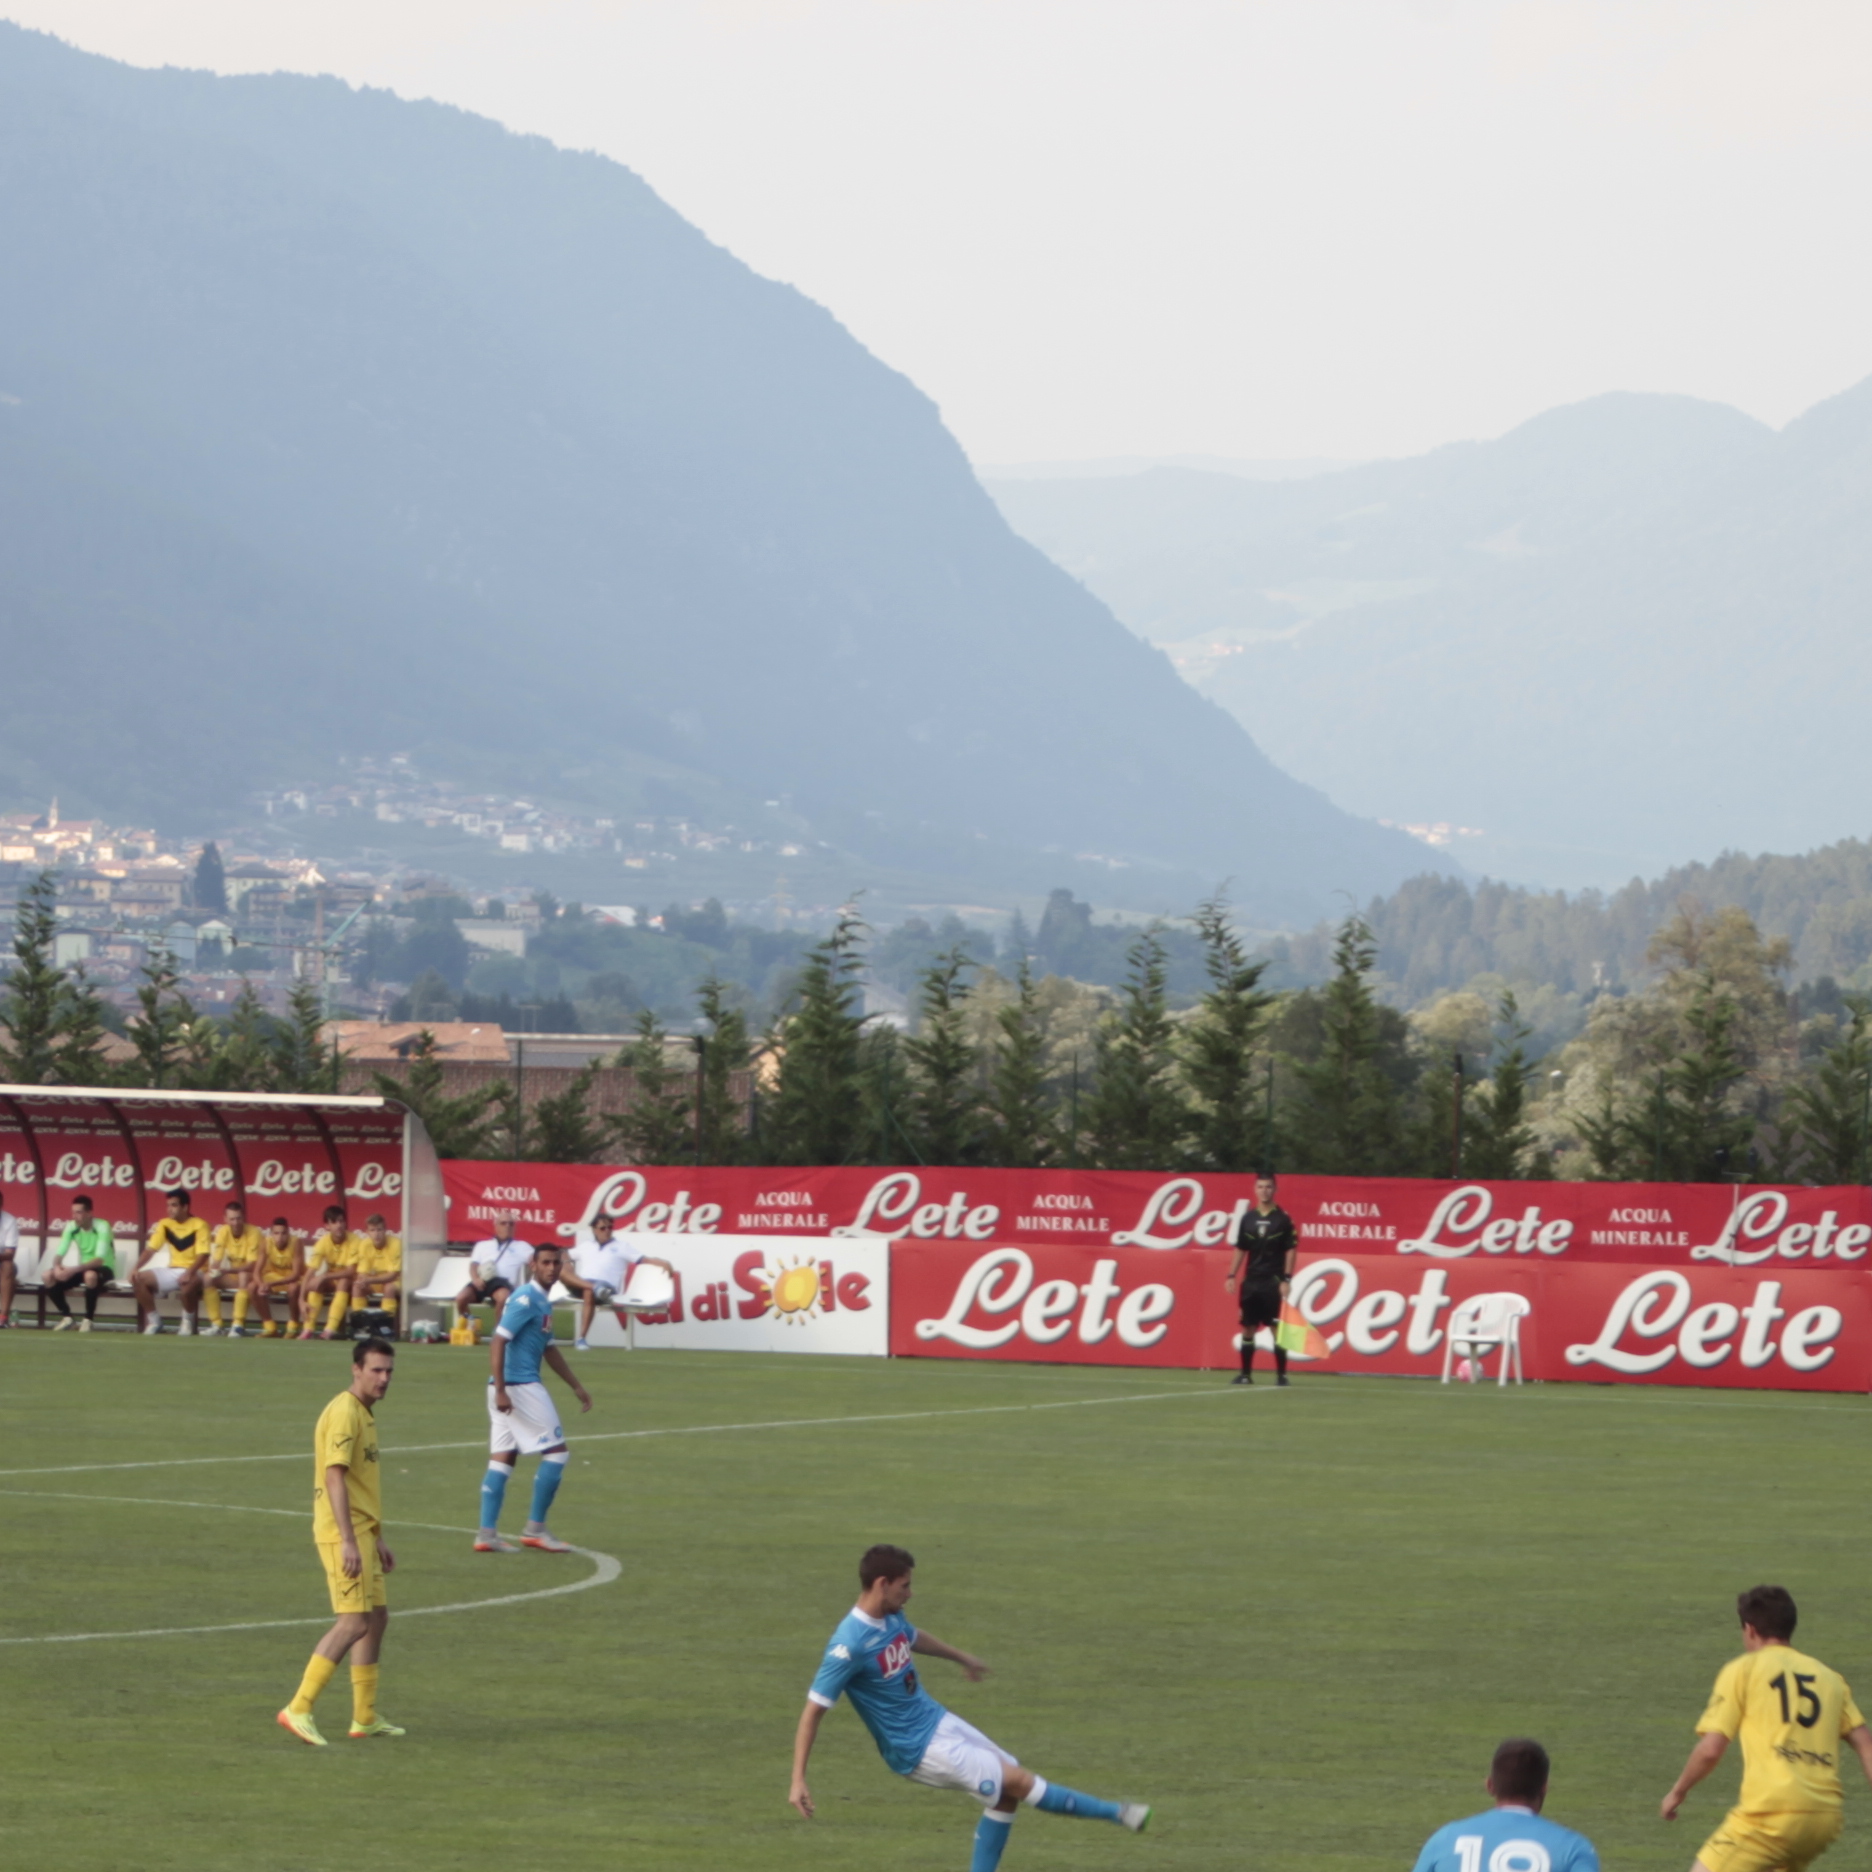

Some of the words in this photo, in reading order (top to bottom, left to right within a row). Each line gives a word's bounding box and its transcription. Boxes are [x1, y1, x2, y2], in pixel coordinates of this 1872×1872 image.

[45, 1152, 135, 1188] Lete
[144, 1155, 235, 1192] Lete
[244, 1159, 336, 1196] Lete
[344, 1162, 403, 1199] Le
[480, 1185, 541, 1203] ACQUA
[556, 1170, 723, 1236] Lete
[754, 1191, 813, 1207] ACQUA
[829, 1171, 1001, 1240] Lete
[1032, 1194, 1094, 1211] ACQUA
[1317, 1201, 1381, 1218] ACQUA
[467, 1205, 556, 1224] MINERALE
[738, 1212, 829, 1228] MINERALE
[1015, 1215, 1111, 1233] MINERALE
[1110, 1177, 1251, 1250] Let
[1301, 1222, 1397, 1240] MINERALE
[1395, 1185, 1574, 1258] Lete
[1608, 1208, 1673, 1224] ACQUA
[1689, 1190, 1872, 1266] Lete
[1590, 1229, 1689, 1247] MINERALE
[690, 1280, 731, 1320] di
[914, 1246, 1176, 1349] Lete
[1564, 1269, 1843, 1375] Lete
[1769, 1671, 1822, 1729] 15
